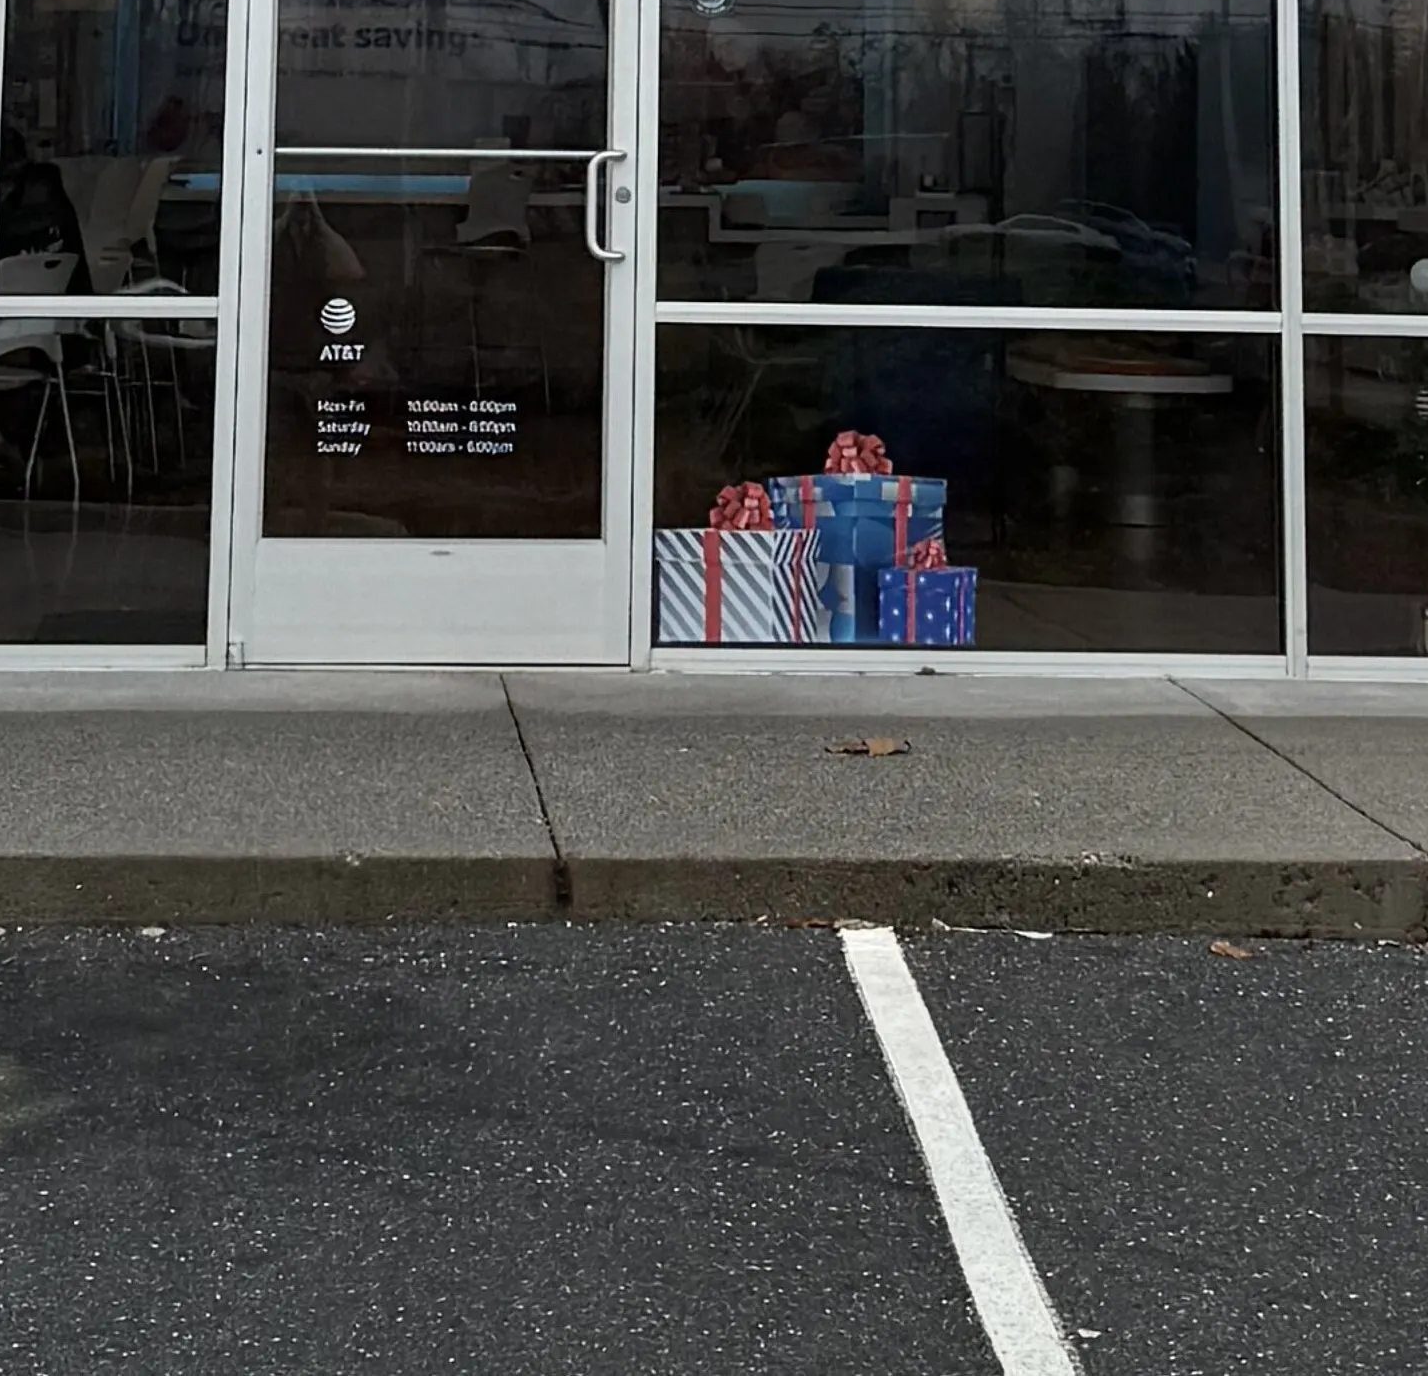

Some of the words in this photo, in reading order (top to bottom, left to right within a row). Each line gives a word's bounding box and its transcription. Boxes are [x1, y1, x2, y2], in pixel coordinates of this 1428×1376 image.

[319, 344, 365, 362] AT&T
[317, 419, 372, 437] Saturday
[317, 440, 362, 457] Sunday
